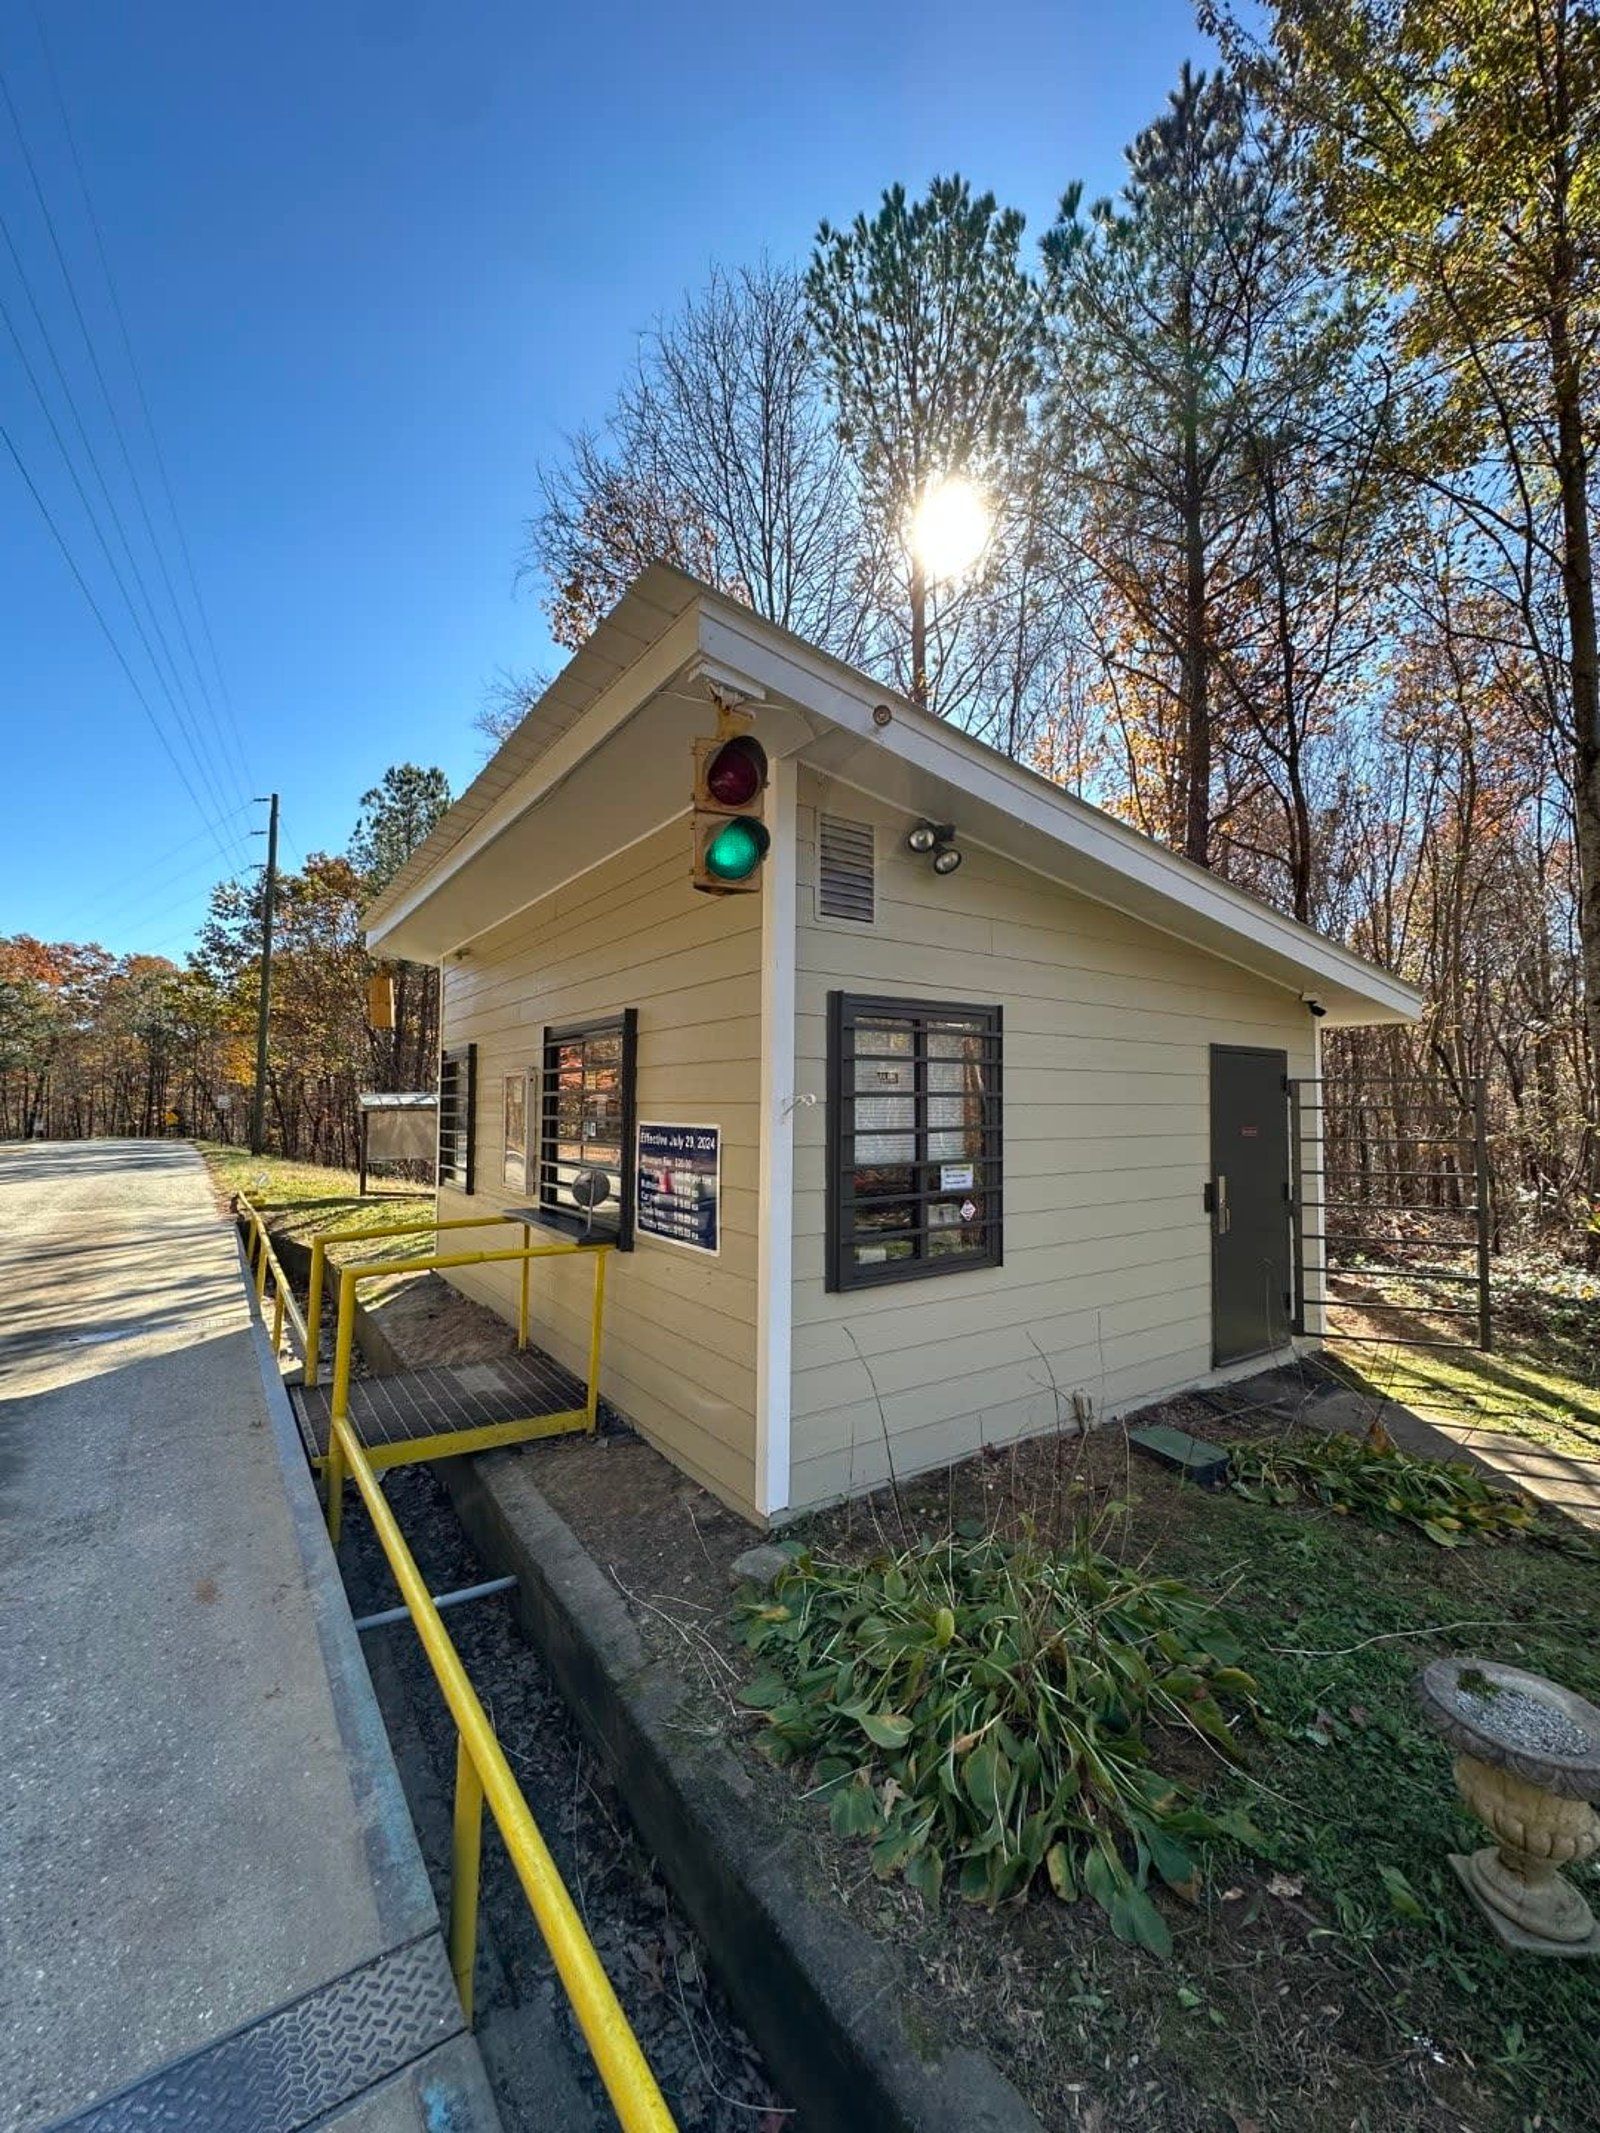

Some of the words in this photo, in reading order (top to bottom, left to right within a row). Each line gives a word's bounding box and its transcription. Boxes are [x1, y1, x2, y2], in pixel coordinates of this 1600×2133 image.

[640, 1132, 668, 1146] Effective
[669, 1134, 684, 1150] July
[697, 1136, 715, 1150] 2024
